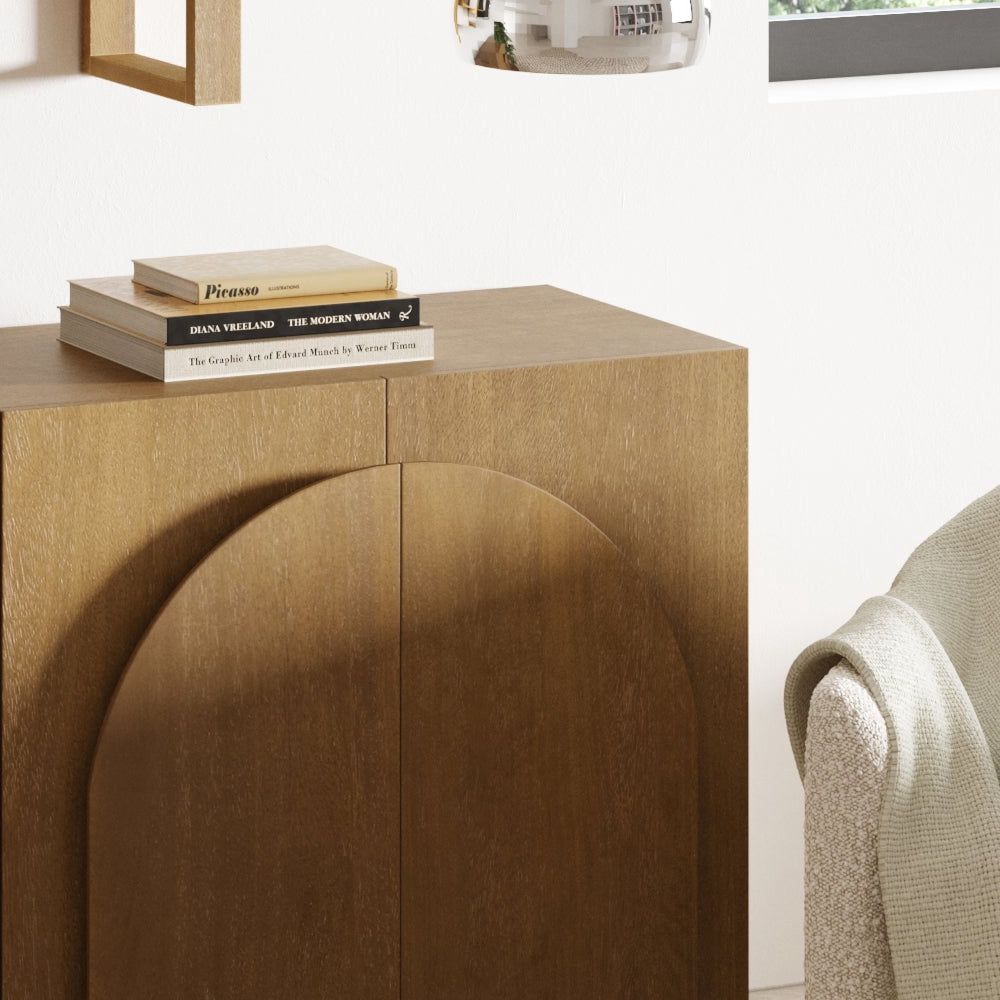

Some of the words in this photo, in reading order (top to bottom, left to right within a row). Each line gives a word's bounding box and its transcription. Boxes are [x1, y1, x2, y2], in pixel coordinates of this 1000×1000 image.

[204, 284, 260, 300] Picasso
[288, 317, 309, 327] THE
[310, 314, 352, 326] MODERN
[354, 311, 391, 322] WOMAN
[190, 325, 221, 335] DIANA
[223, 320, 275, 333] VREELAND
[189, 357, 206, 366] The
[208, 353, 243, 366] Graphic
[246, 353, 261, 362] Art
[263, 351, 273, 360] of
[276, 348, 307, 359] Edvard
[309, 346, 339, 357] Munch
[342, 345, 352, 356] by
[355, 342, 388, 353] Werner
[390, 341, 416, 350] Timm
